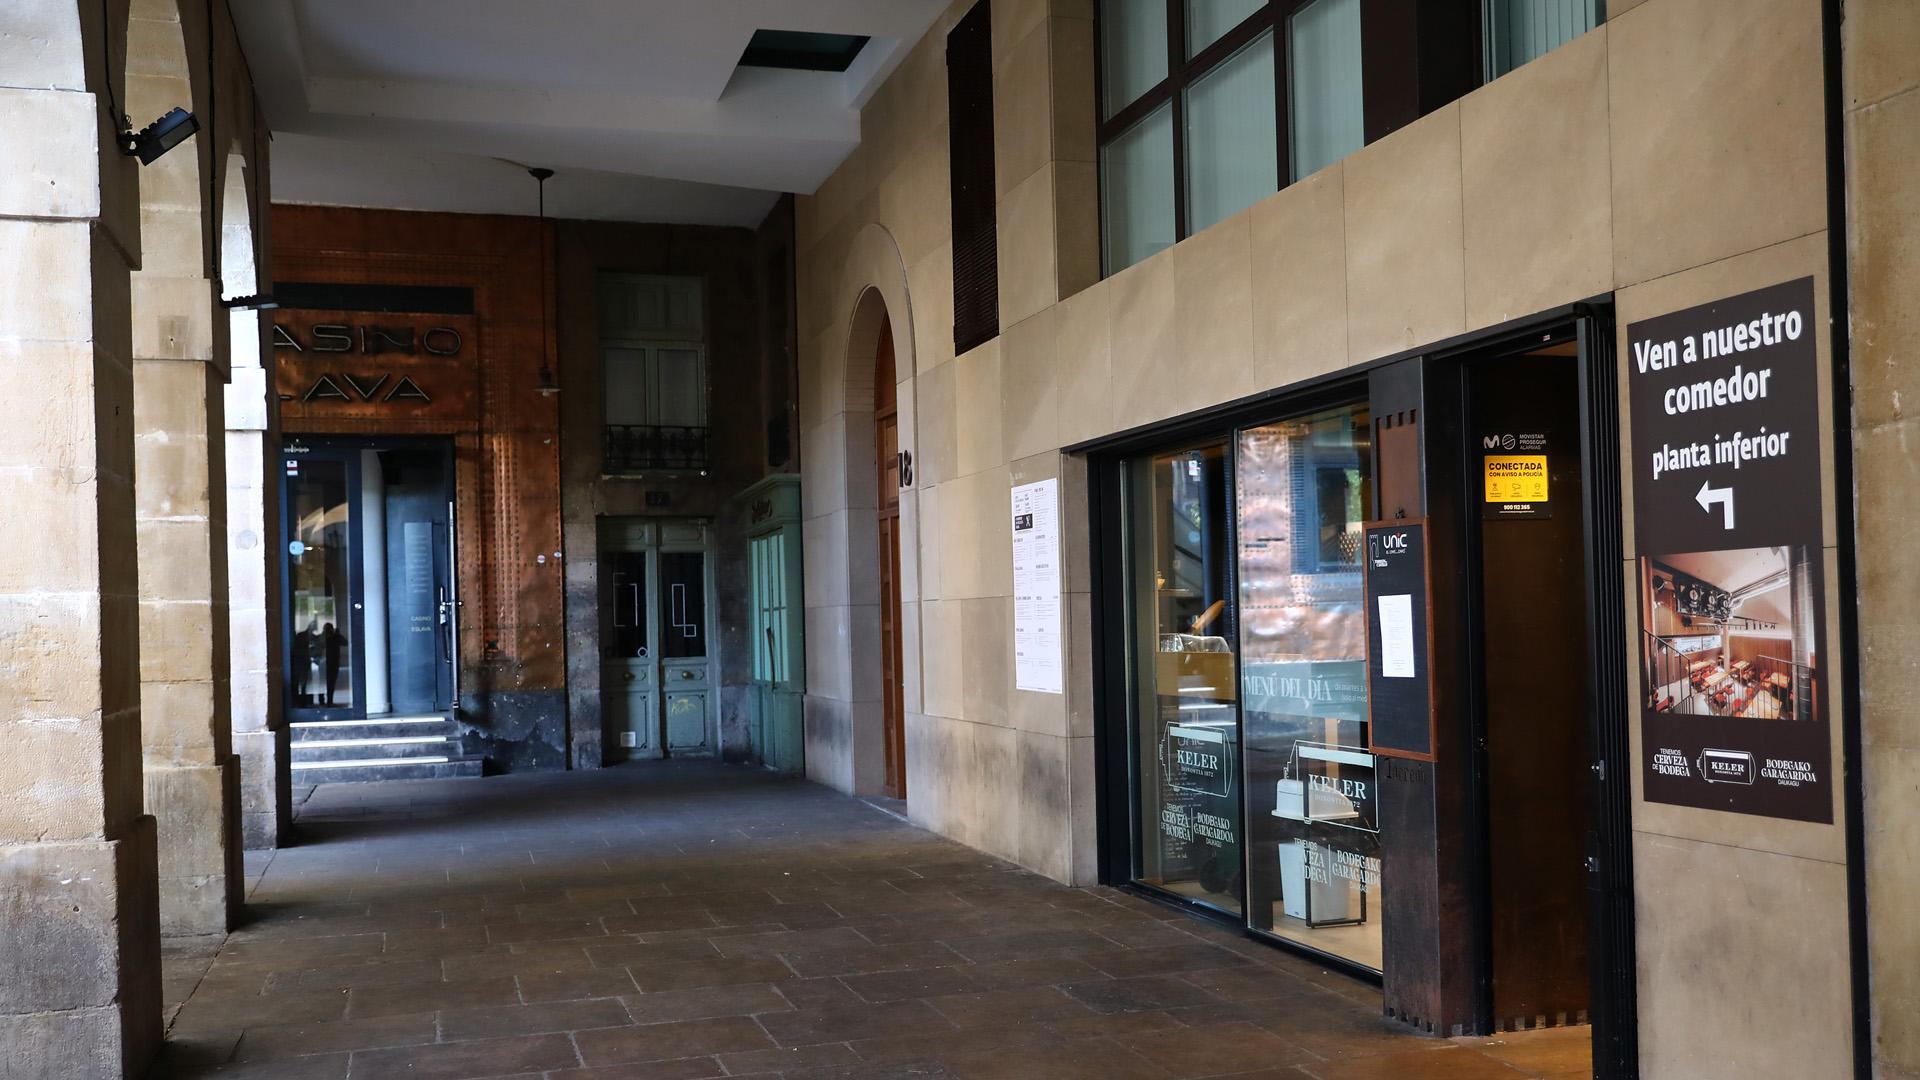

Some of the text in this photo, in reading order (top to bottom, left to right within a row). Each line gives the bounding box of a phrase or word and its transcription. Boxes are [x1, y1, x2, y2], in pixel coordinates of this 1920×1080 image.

[273, 324, 462, 354] ASINO
[1633, 310, 1802, 374] Ven a nuestro
[1664, 365, 1771, 416] comedor
[1652, 426, 1790, 481] planta inferior
[899, 449, 913, 488] 18
[1488, 462, 1543, 471] CONECTADA
[1245, 672, 1277, 697] MENÚ
[1281, 678, 1302, 700] DEL
[1308, 674, 1333, 701] DÍA
[1176, 749, 1218, 770] KELER
[1653, 754, 1688, 767] CERVEZA
[1660, 748, 1682, 756] TENEMOS
[1659, 764, 1691, 777] BODEGA
[1711, 761, 1745, 773] KELER
[1765, 758, 1811, 772] BODEGAKO
[1760, 767, 1817, 783] GARAGARDOA
[1308, 773, 1367, 800] KELER
[1161, 810, 1189, 828] CERVEZA
[1197, 812, 1230, 830] BODEGAKO
[1166, 823, 1191, 841] BODEGA
[1193, 822, 1234, 844] GARAGARDOA
[1332, 862, 1381, 885] GARAGARDO
